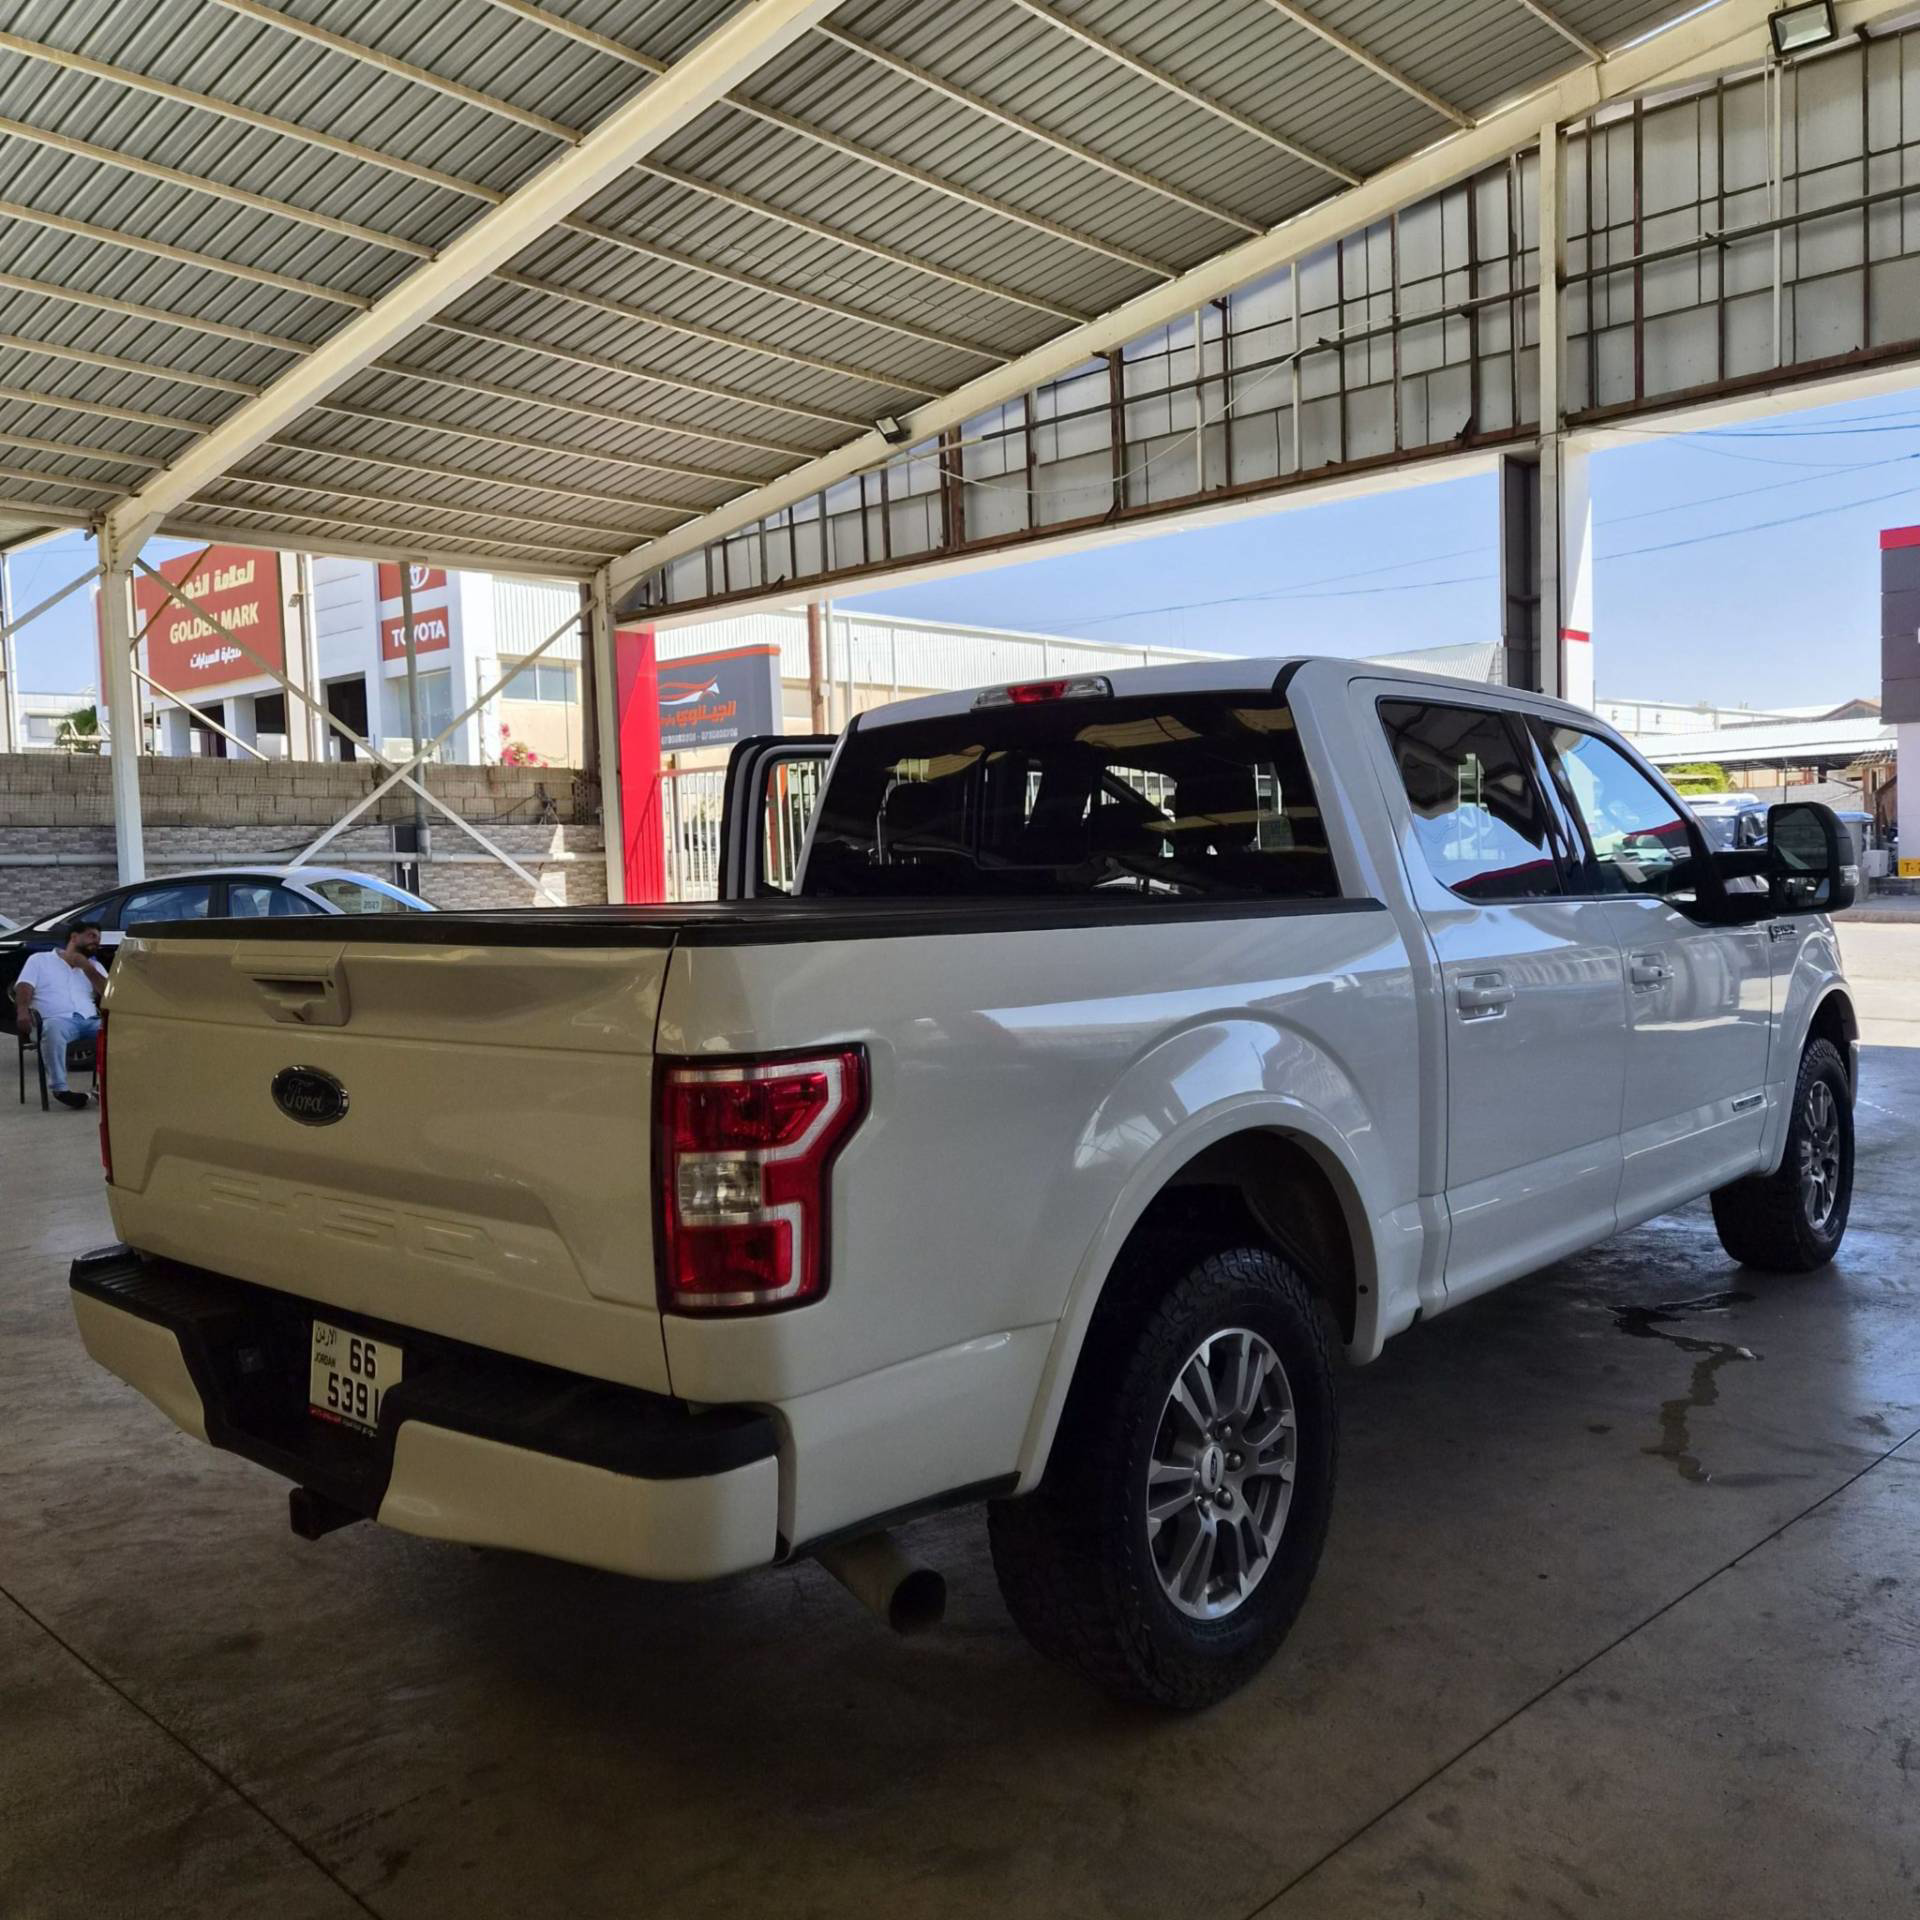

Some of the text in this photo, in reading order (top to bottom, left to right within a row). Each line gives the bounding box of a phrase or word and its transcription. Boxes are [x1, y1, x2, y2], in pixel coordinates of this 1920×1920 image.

[221, 602, 259, 630] MARK
[314, 1352, 336, 1368] JORDAN
[349, 1338, 376, 1380] 66
